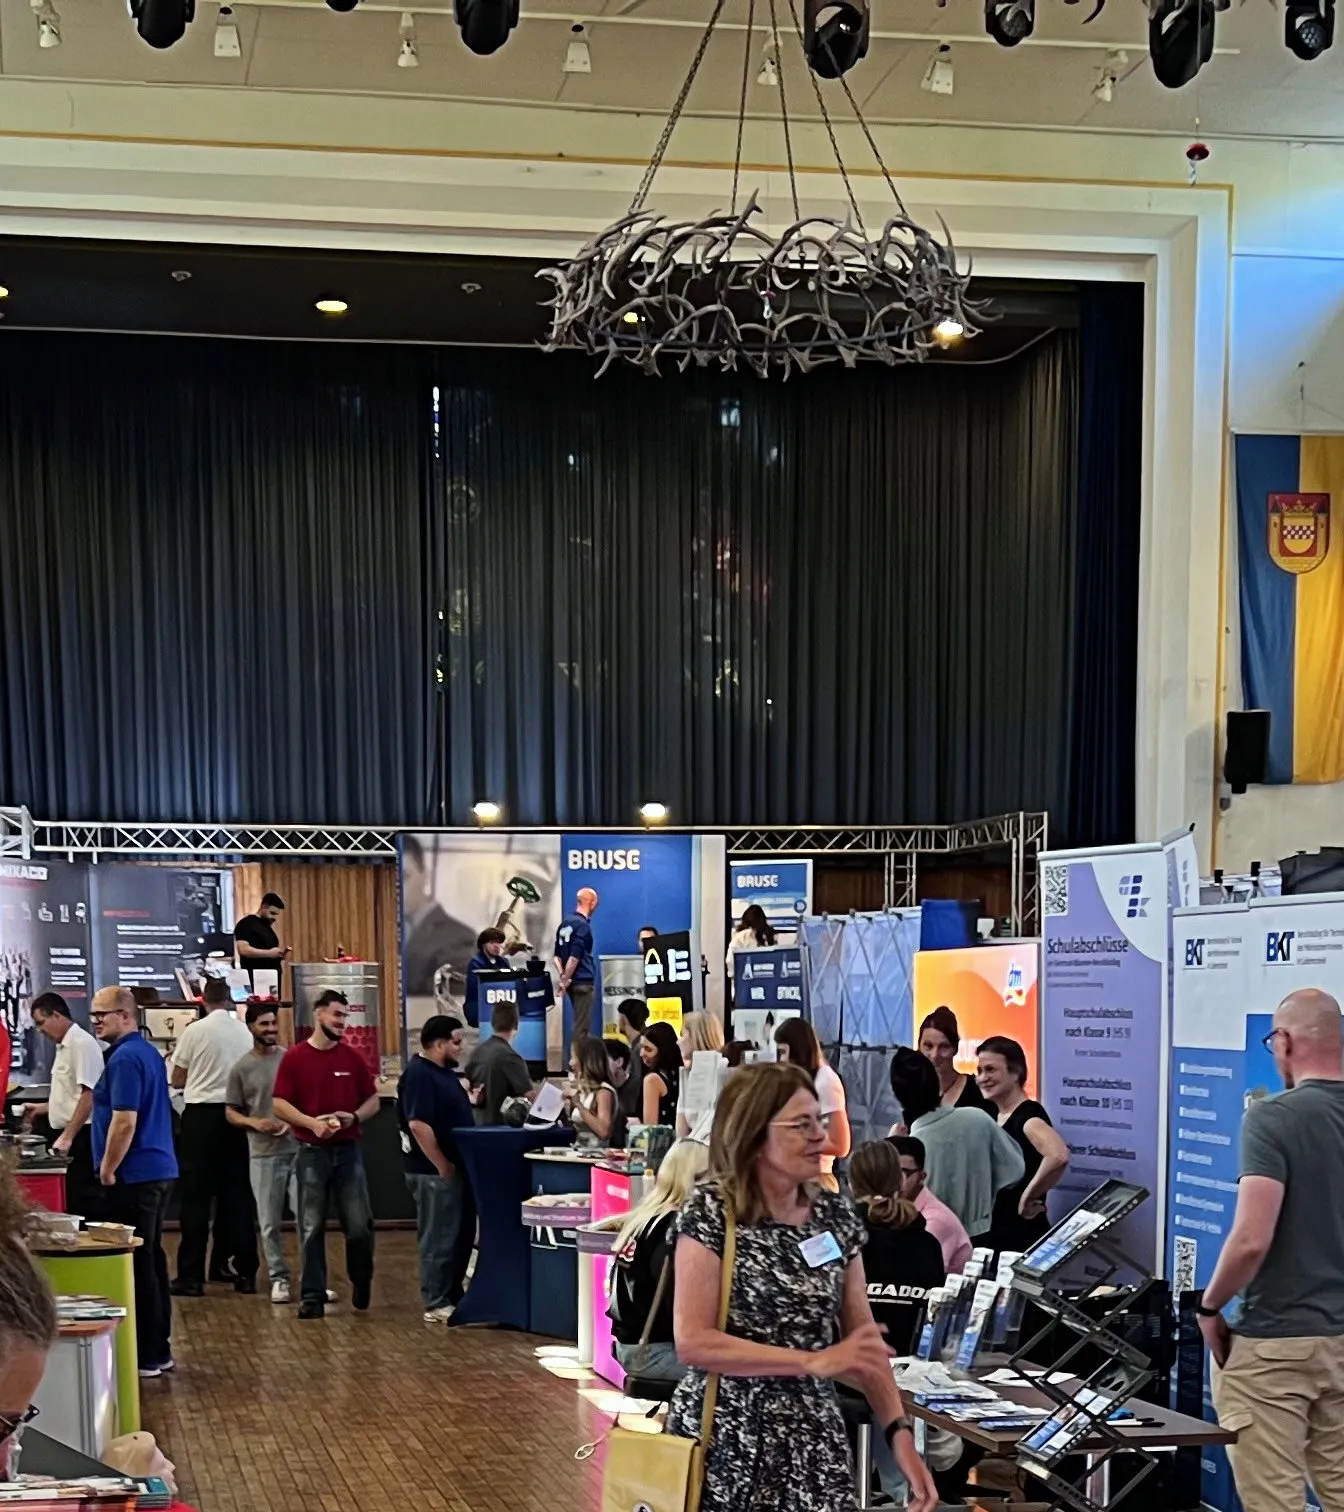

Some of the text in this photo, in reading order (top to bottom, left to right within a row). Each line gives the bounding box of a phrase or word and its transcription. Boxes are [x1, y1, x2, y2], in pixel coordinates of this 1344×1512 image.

[568, 849, 641, 871] BRUSE
[737, 874, 779, 889] BRUSE
[1047, 936, 1129, 954] Schulabschlüsse
[1267, 930, 1295, 962] BKT
[486, 988, 517, 1004] BRU
